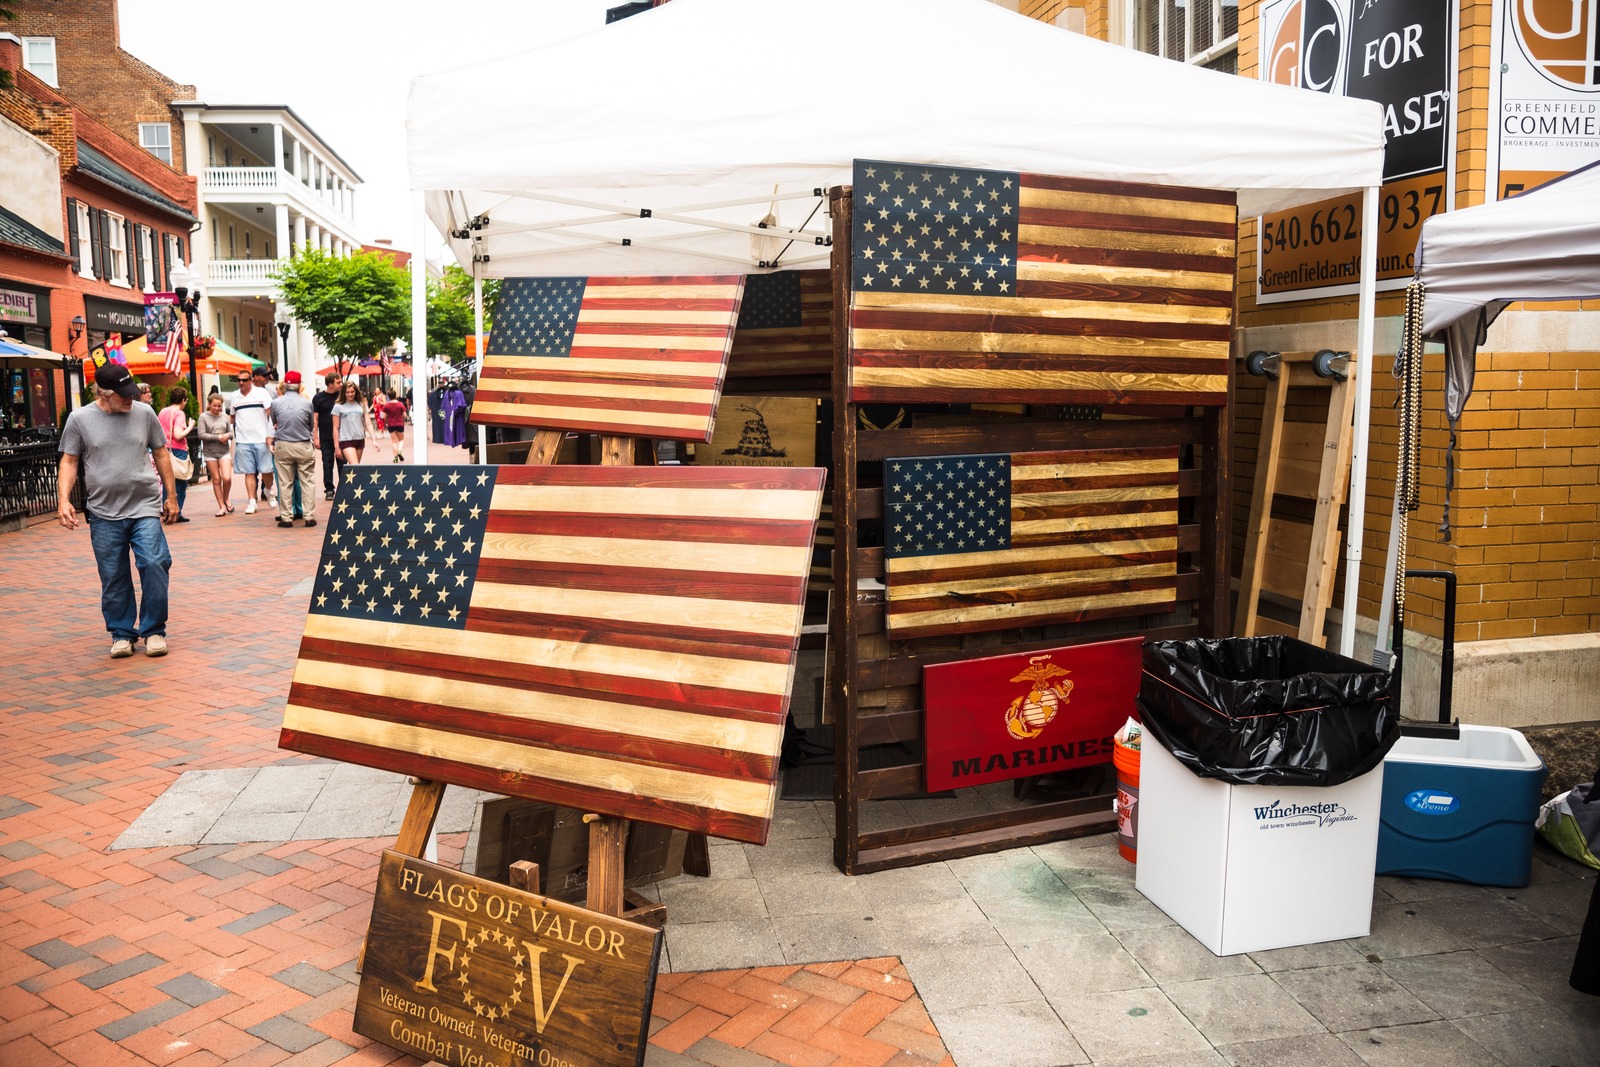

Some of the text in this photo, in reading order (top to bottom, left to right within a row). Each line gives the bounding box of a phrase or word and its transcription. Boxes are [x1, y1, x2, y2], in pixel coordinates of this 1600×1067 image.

[1362, 23, 1425, 77] FOR
[1382, 90, 1444, 144] ASE
[1504, 102, 1596, 114] GREENFIELD
[1504, 115, 1600, 135] COMME
[1263, 185, 1443, 255] 540.662.937
[108, 311, 142, 328] MOUNTAIN
[741, 459, 767, 467] TREAD
[951, 735, 1115, 778] MARINES
[1254, 801, 1339, 820] Winchester
[1286, 820, 1316, 828] winchester
[1319, 813, 1358, 828] Virginia
[400, 867, 627, 960] FLAGS OF VALOR
[379, 986, 426, 1019] Veteran
[429, 1006, 477, 1040] Owned.
[482, 1025, 536, 1062] Veteran
[390, 1018, 454, 1063] Combat
